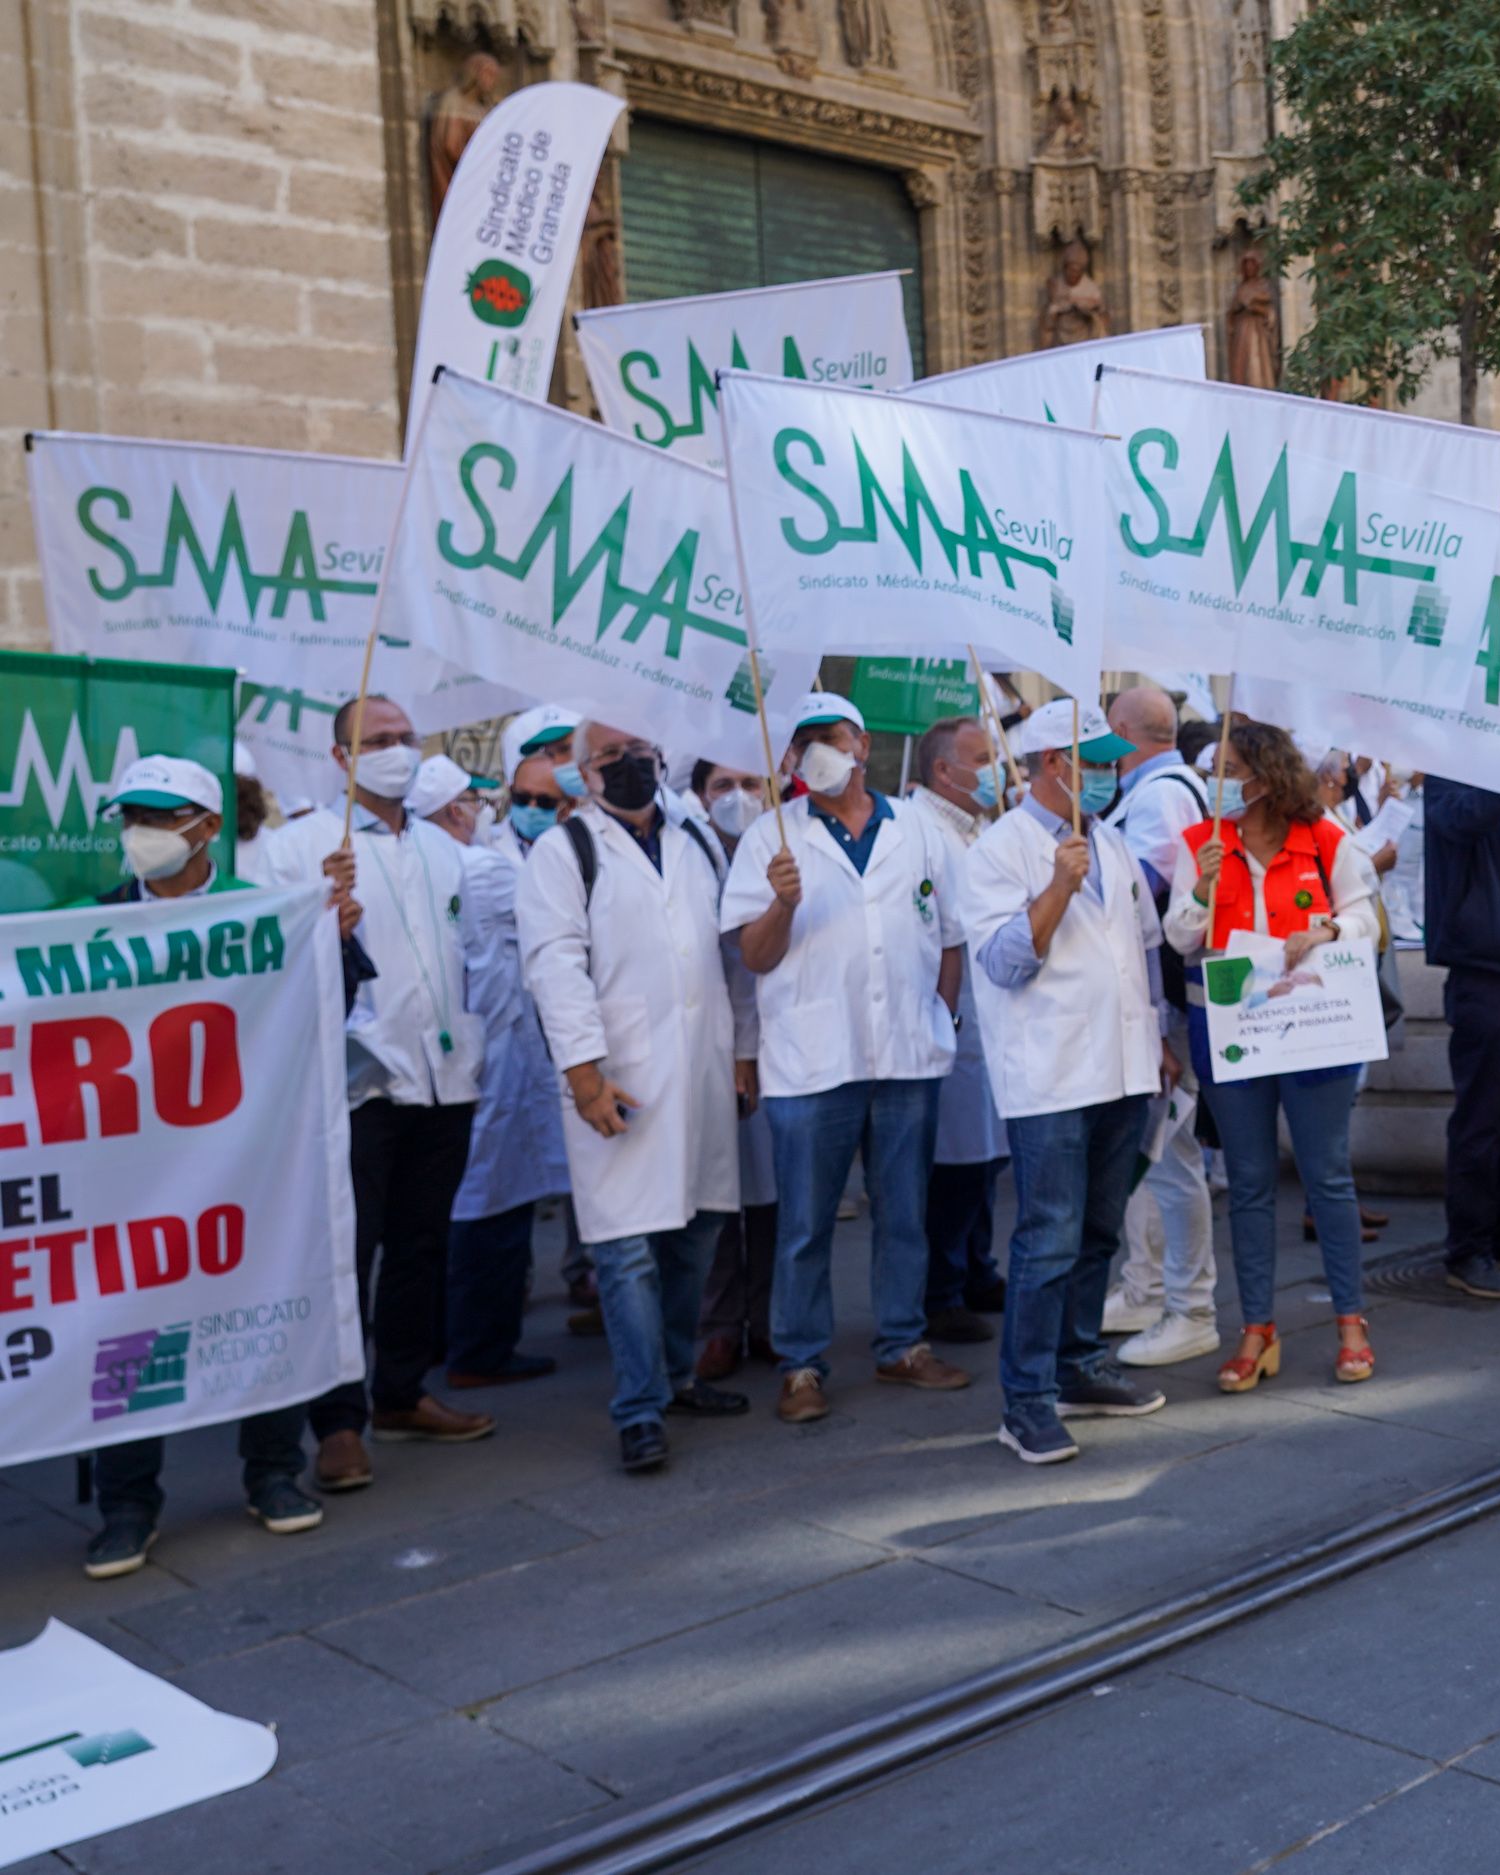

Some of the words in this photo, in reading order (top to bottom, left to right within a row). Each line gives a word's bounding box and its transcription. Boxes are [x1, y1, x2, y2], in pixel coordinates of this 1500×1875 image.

[476, 131, 524, 248] Sindicato
[504, 167, 544, 257] Médico
[530, 129, 552, 162] de
[529, 162, 571, 265] Granada
[811, 351, 887, 382] Sevilla
[774, 426, 1057, 589] SMA
[994, 508, 1073, 562] Sevilla
[1120, 427, 1435, 606] SMA
[1361, 512, 1463, 559] Sevilla
[77, 483, 378, 622] SMA
[436, 442, 747, 660] SMA
[798, 574, 868, 591] Sindicato
[876, 573, 930, 590] Médico
[933, 579, 982, 603] Andaluz
[433, 579, 497, 618] Sindicato
[502, 605, 559, 645] Médico
[560, 635, 621, 668] Andaluz
[631, 661, 714, 702] Federación
[1118, 570, 1182, 602] Sindicato
[1187, 590, 1244, 614] Médico
[1246, 601, 1306, 626] Andaluz
[1317, 614, 1397, 642] Federación
[15, 915, 286, 998] MÁLAGA
[1237, 1005, 1297, 1022] SALVEMOS
[1298, 998, 1352, 1016] NUESTRA
[196, 1295, 312, 1340] SINDICATO
[197, 1329, 288, 1366] MÉDICO
